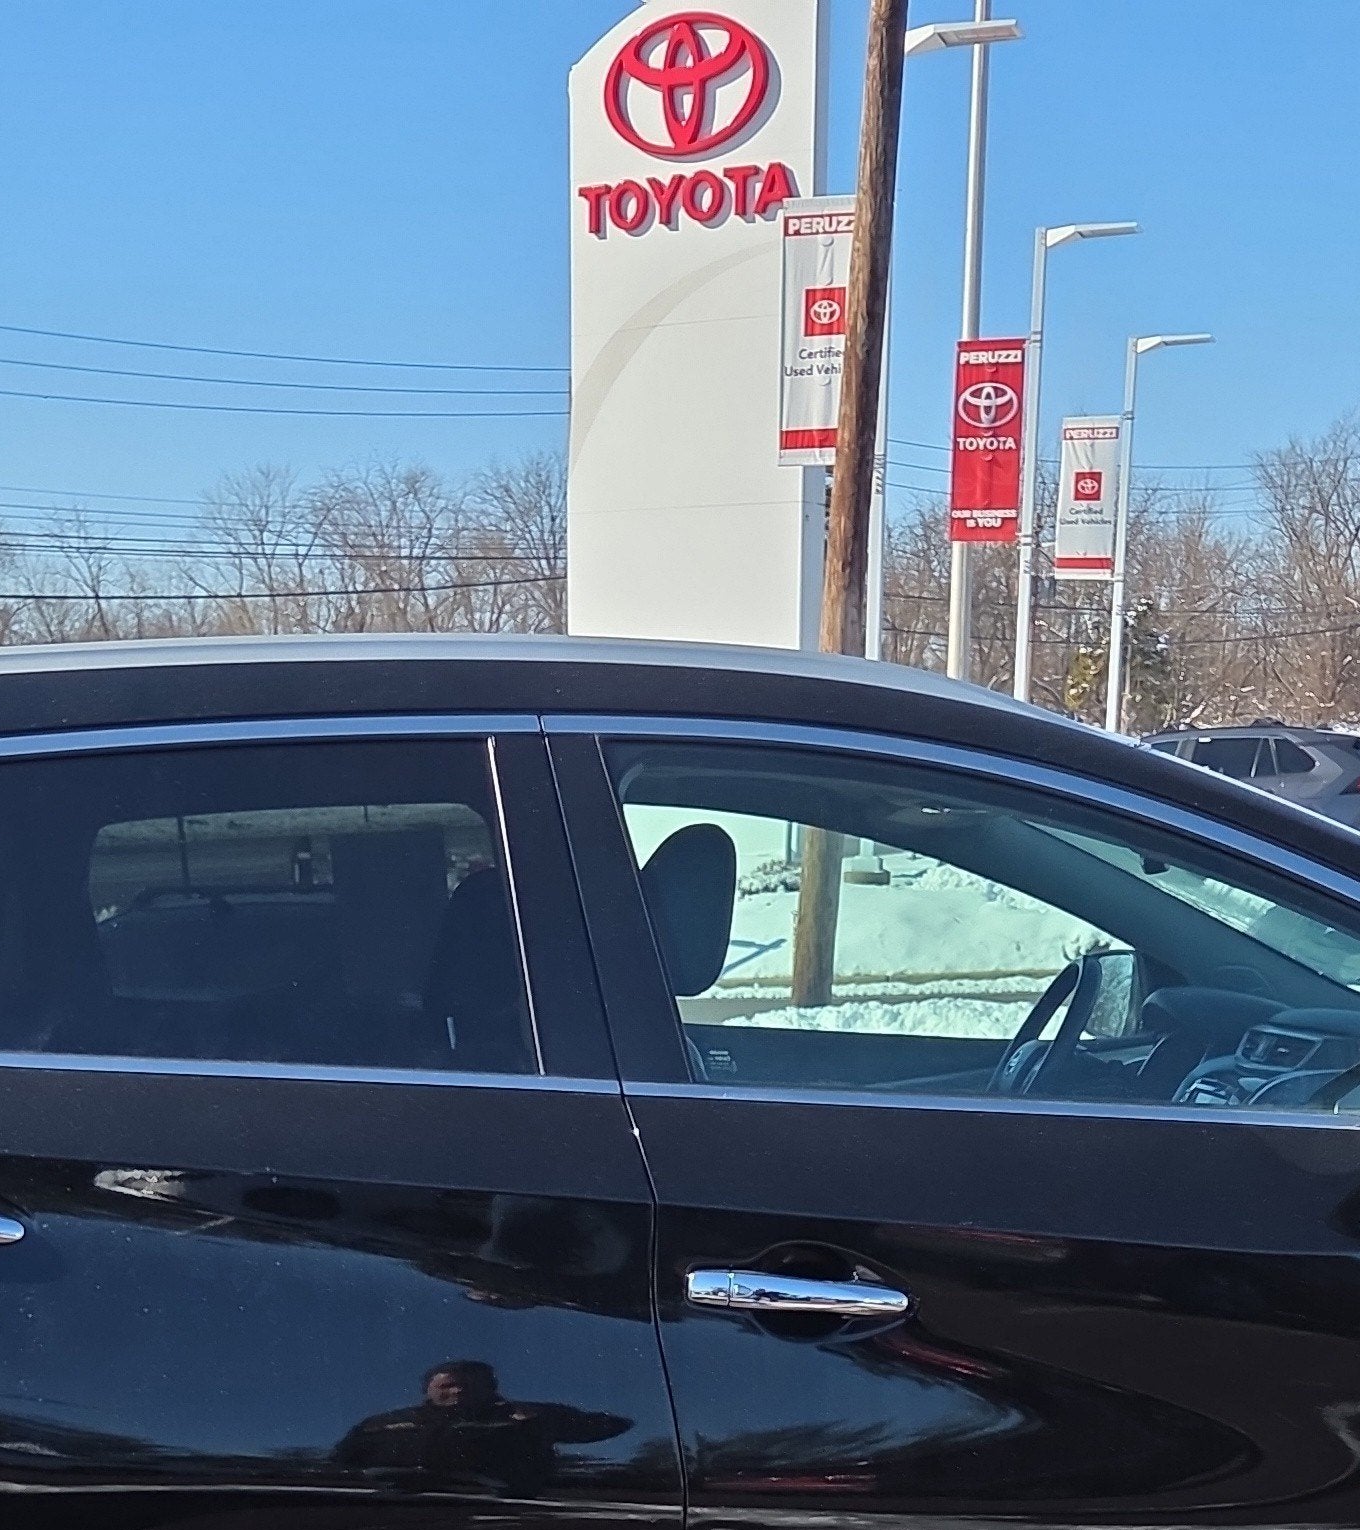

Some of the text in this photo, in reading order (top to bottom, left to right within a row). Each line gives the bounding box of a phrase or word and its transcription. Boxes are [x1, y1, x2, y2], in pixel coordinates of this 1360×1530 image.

[579, 162, 791, 234] TOYOTA
[787, 215, 856, 234] PERUZ
[798, 345, 843, 360] Certifie
[959, 350, 1022, 364] PERUZZI
[784, 363, 842, 377] Used Vehi
[1066, 429, 1117, 438] PERUZZI
[957, 436, 1017, 451] TOYOTA
[977, 517, 1002, 528] YOU
